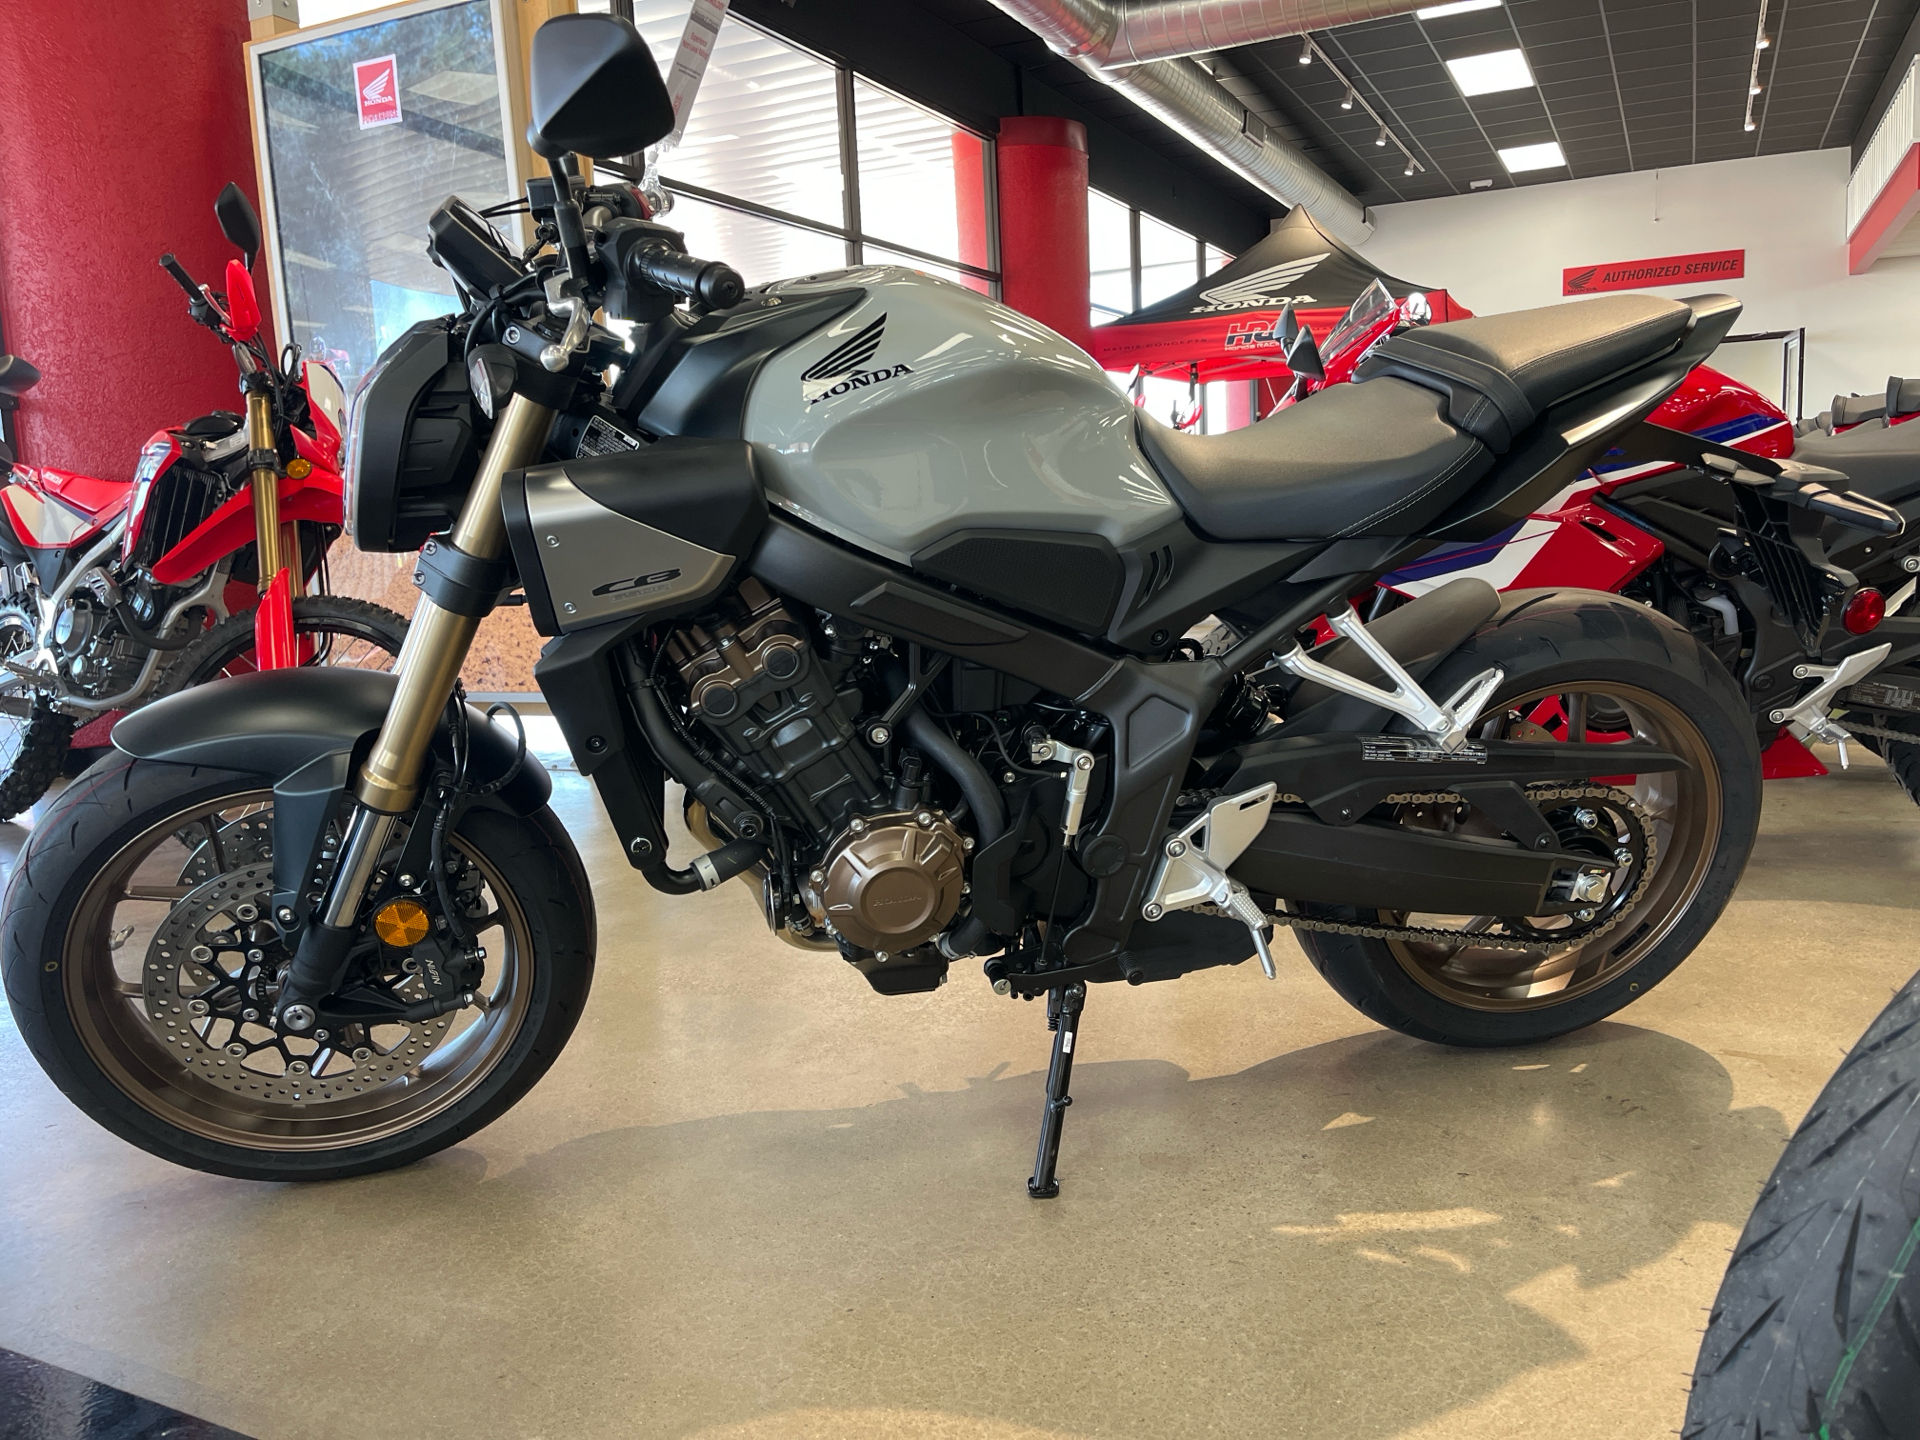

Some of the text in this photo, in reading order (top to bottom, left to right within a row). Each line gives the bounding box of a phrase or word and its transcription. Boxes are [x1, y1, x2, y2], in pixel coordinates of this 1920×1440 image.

[364, 95, 393, 106] HONDA
[1602, 259, 1739, 283] AUTHORIZED SERVICE
[1190, 294, 1318, 314] HONDA
[1256, 340, 1280, 348] RACI
